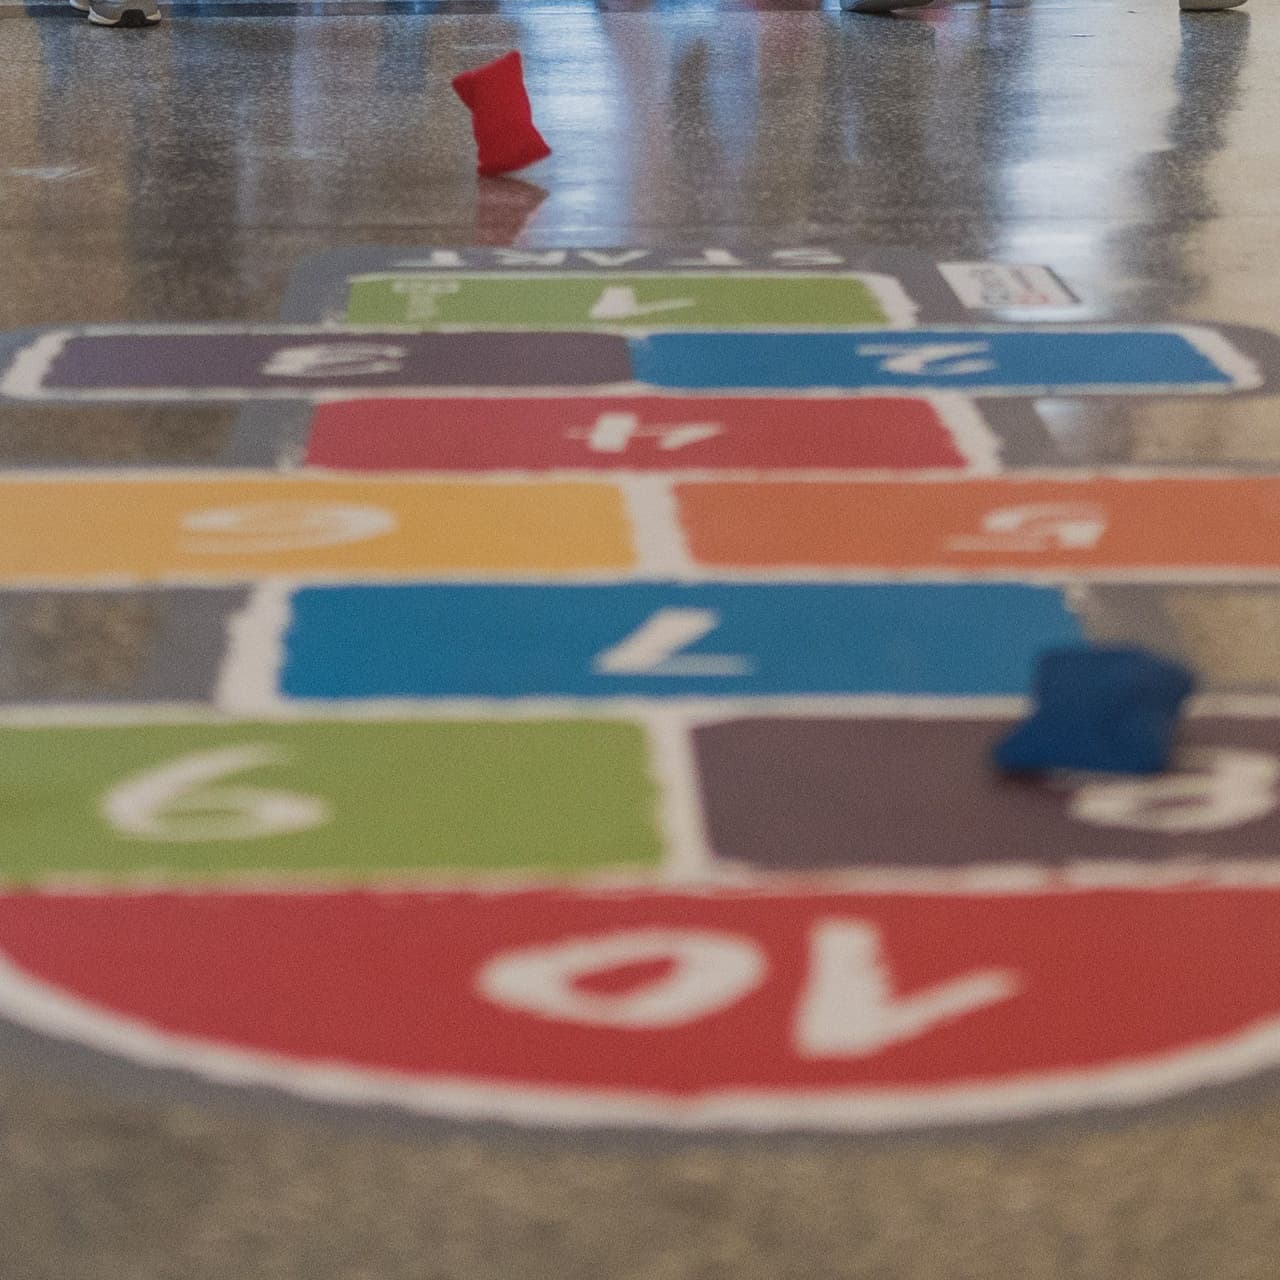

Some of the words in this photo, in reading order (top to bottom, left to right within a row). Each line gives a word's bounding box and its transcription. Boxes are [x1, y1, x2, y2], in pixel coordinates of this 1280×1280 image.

[392, 248, 845, 267] START
[590, 286, 696, 318] 1
[262, 342, 407, 377] 3
[854, 342, 997, 375] 2
[564, 412, 723, 452] 4
[173, 501, 398, 554] 6
[944, 502, 1106, 551] 5
[592, 607, 758, 676] 7
[99, 740, 331, 842] 9
[474, 918, 1024, 1061] 10
